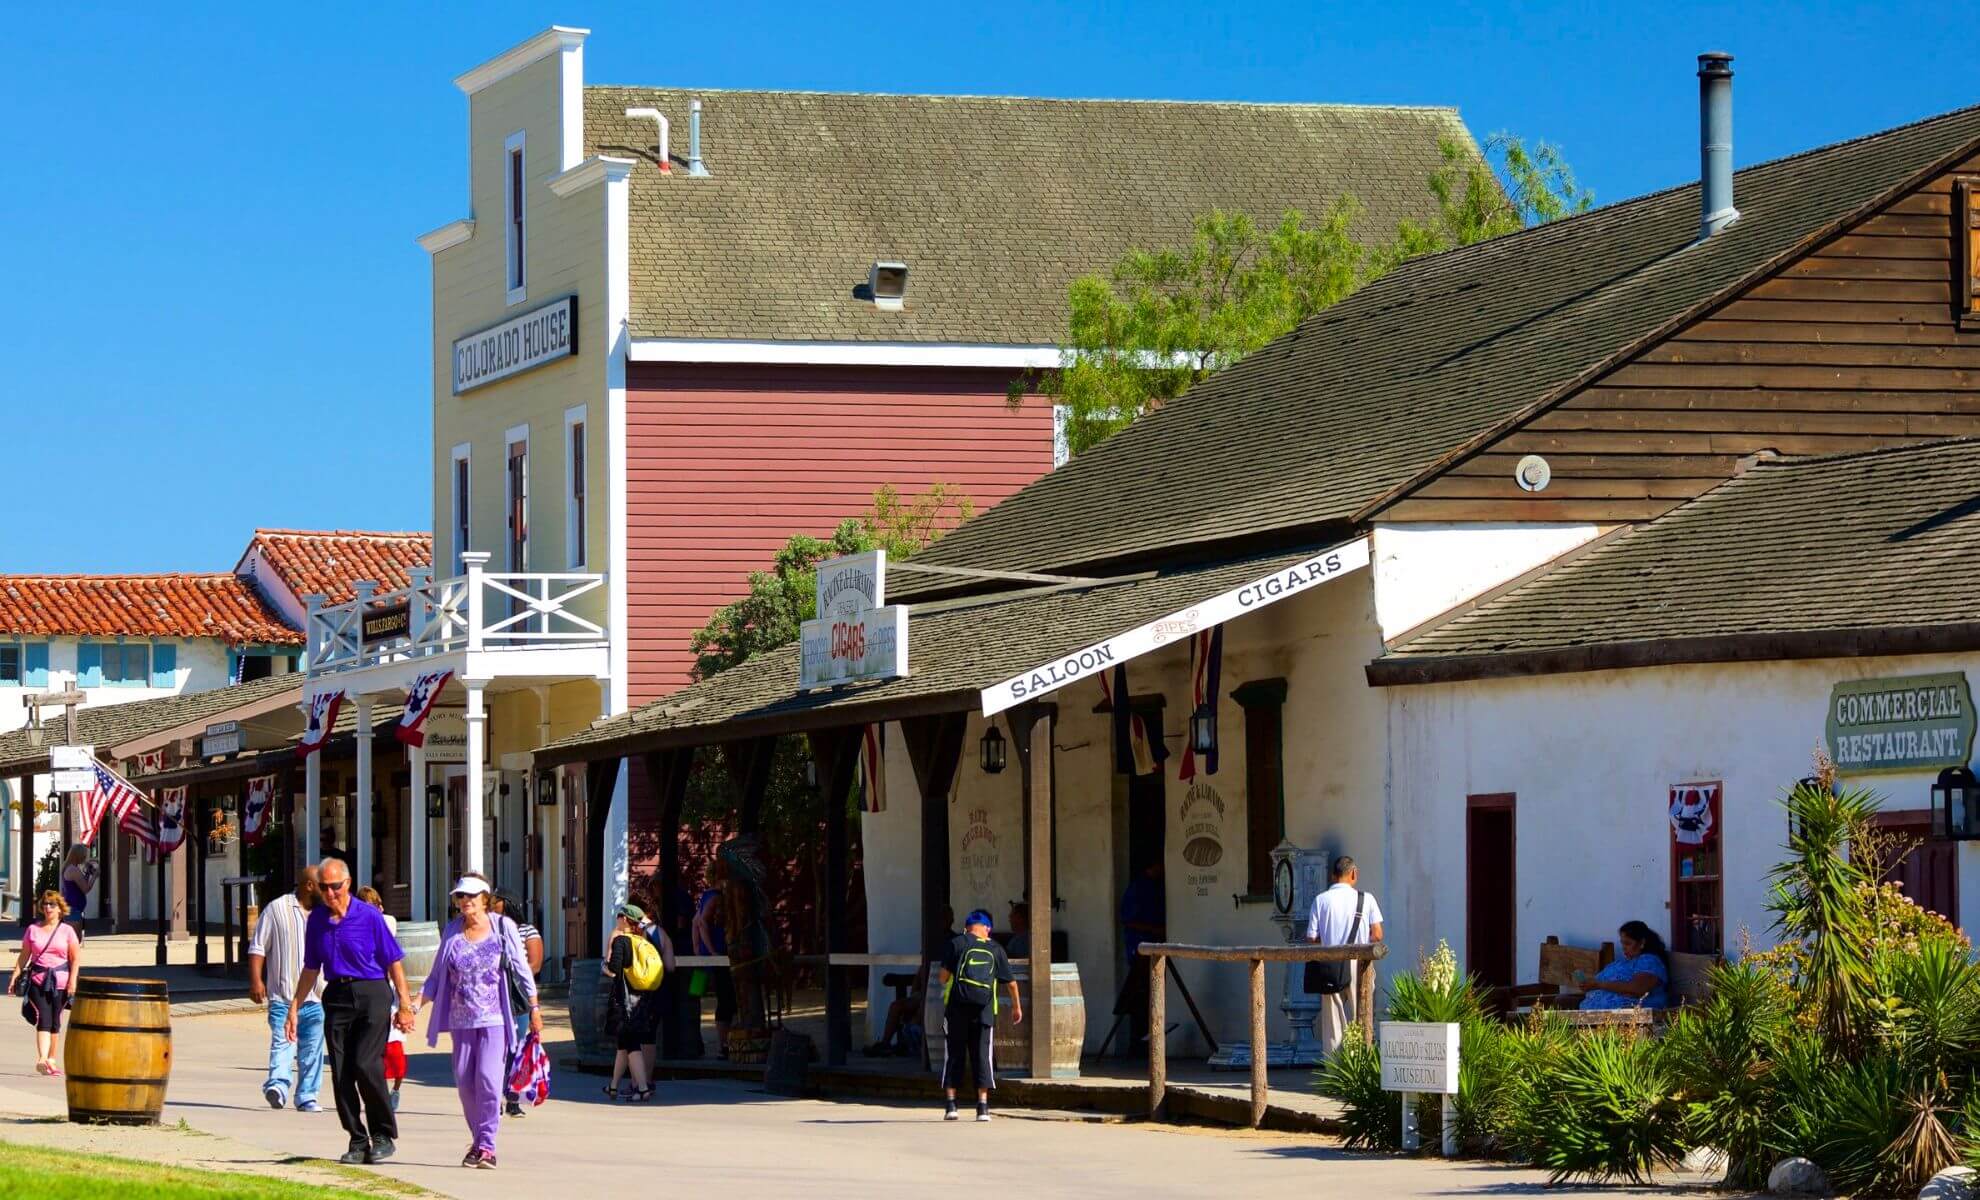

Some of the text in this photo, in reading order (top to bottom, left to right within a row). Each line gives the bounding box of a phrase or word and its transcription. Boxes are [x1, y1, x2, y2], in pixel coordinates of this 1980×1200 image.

[458, 327, 520, 384] COLORADO
[831, 621, 865, 662] CIGARS
[1010, 553, 1343, 699] SALOON PIPES CIGARS
[1836, 686, 1961, 726] COMMERCIAL
[1836, 728, 1961, 763] RESTAURANT.
[1384, 1040, 1418, 1058] MACHADO
[1393, 1067, 1436, 1084] MUSEUM
